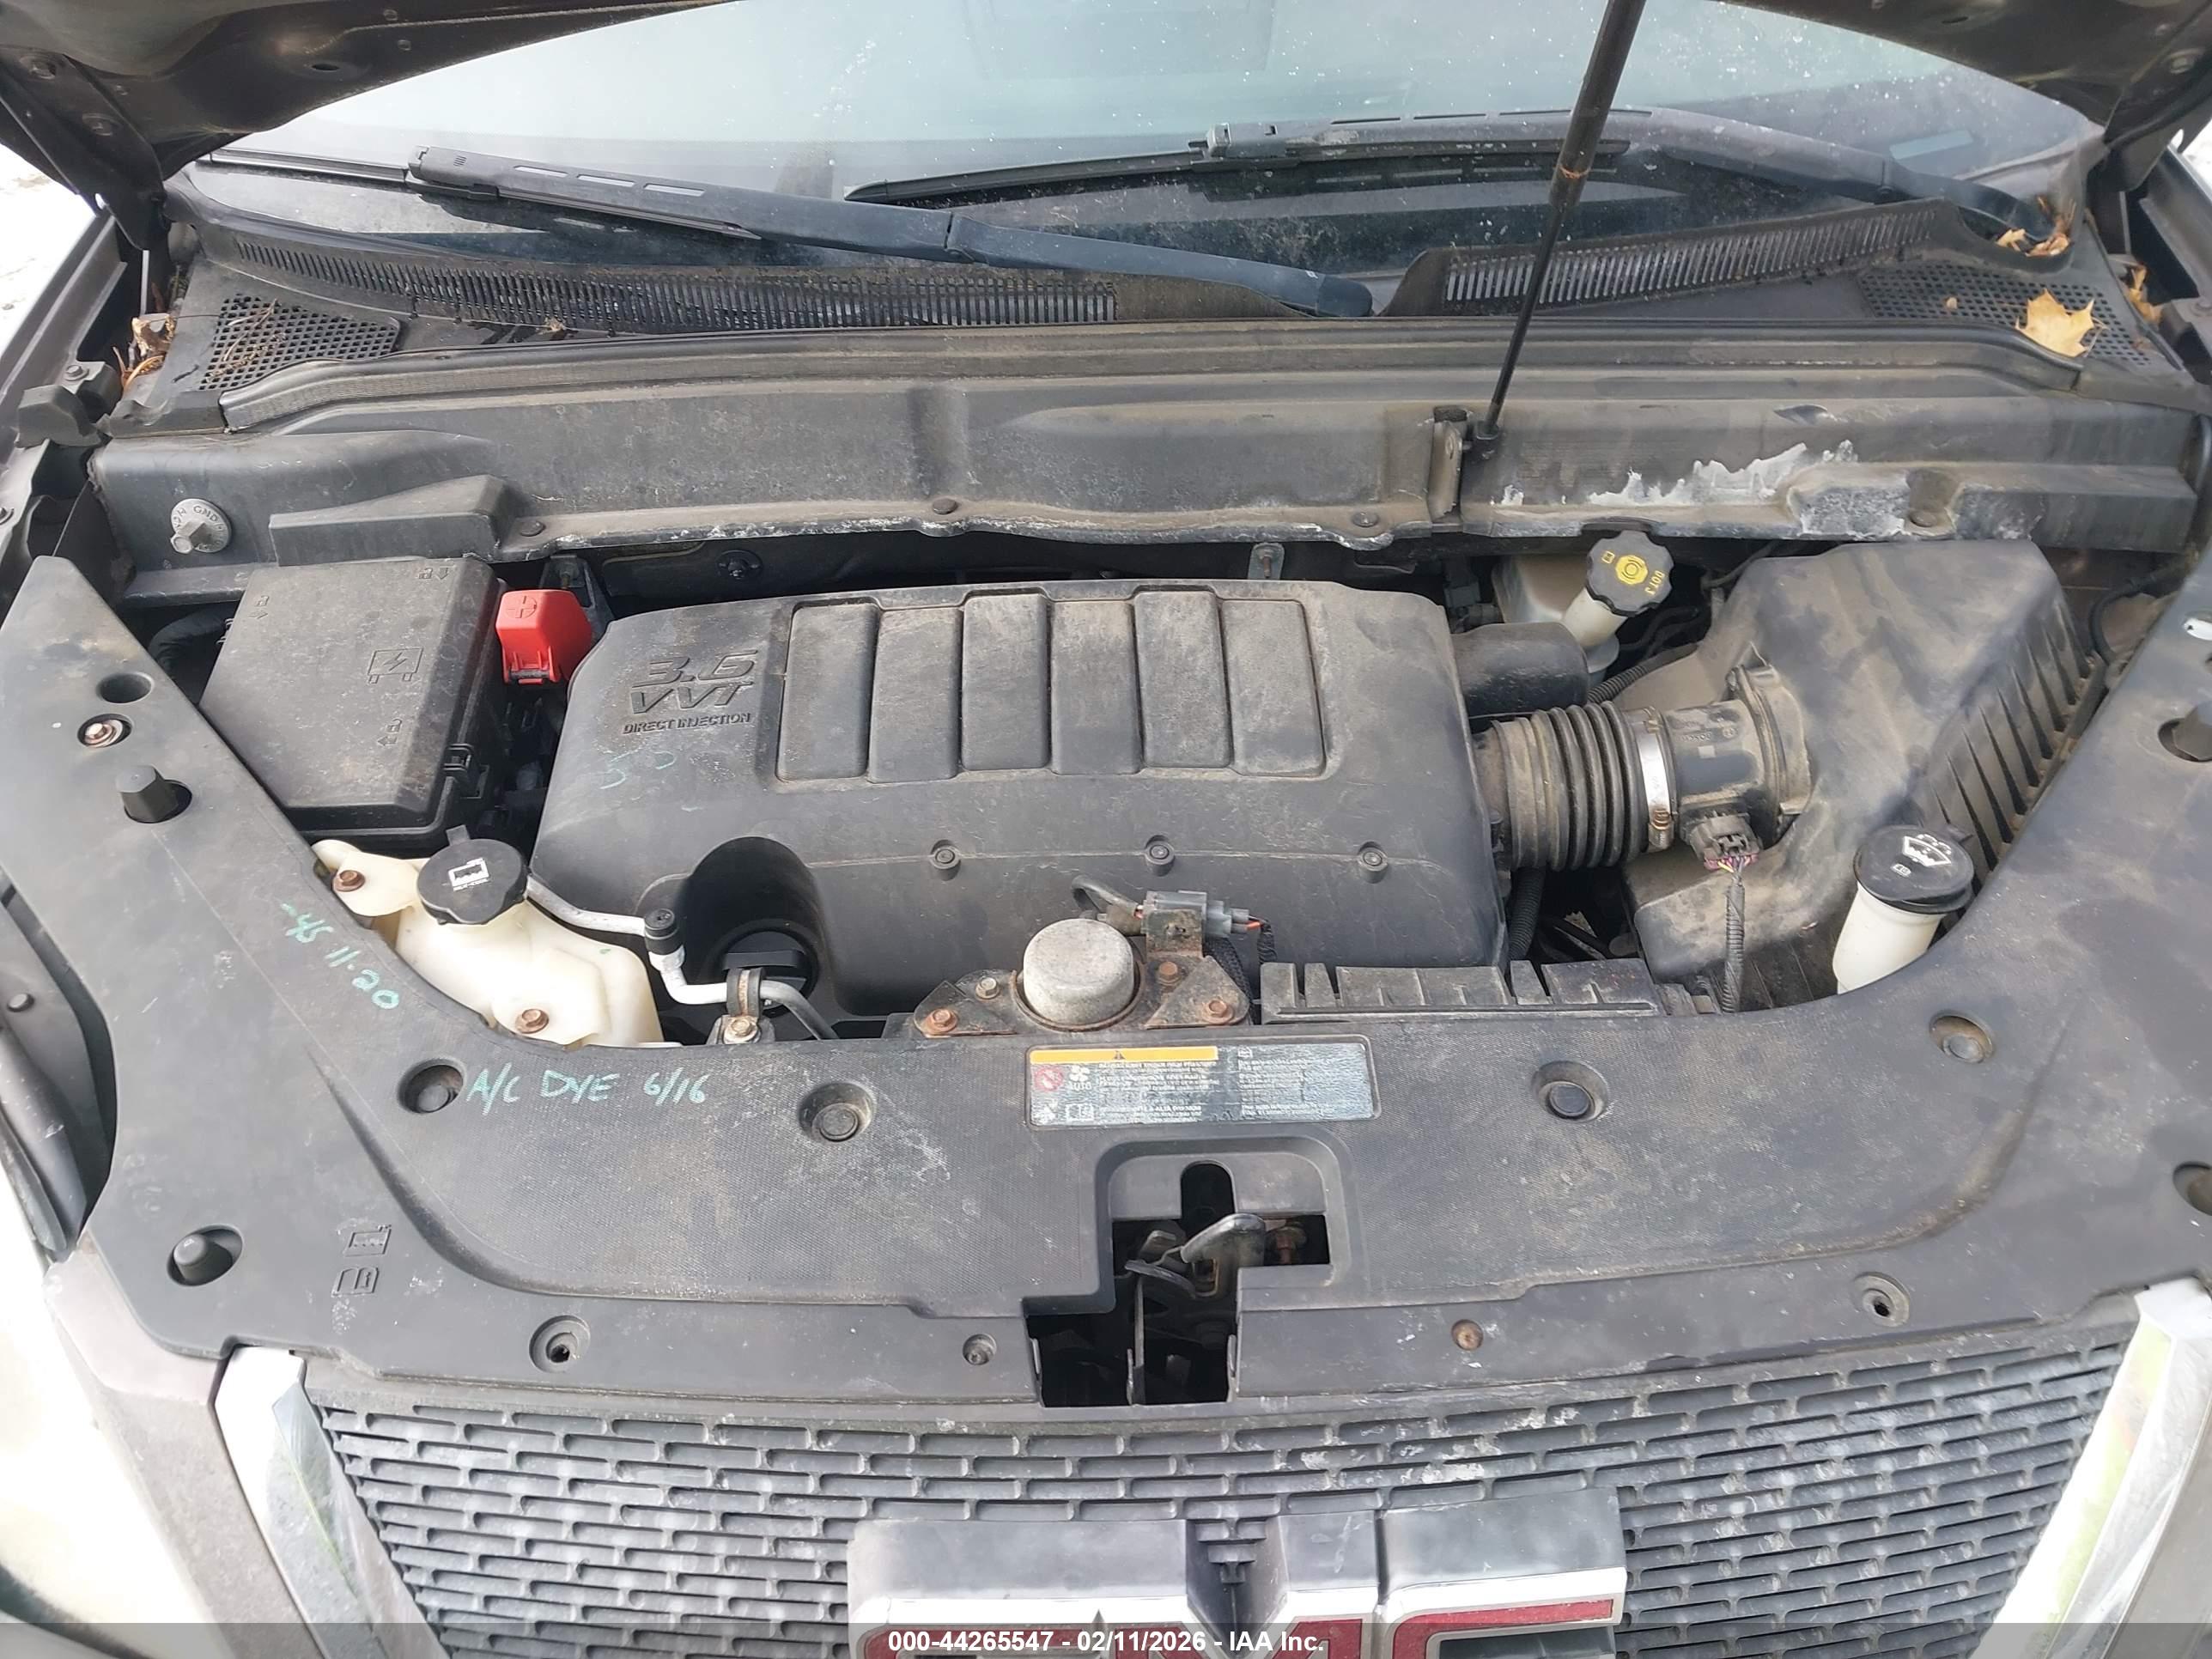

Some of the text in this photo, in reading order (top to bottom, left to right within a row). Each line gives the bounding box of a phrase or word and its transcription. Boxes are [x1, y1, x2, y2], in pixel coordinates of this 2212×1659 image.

[1649, 569, 1665, 589] DOT
[631, 650, 758, 688] 3.6
[630, 681, 755, 714] VVT
[623, 713, 751, 734] DIRECT INJECTION
[466, 1062, 521, 1115] A/C
[540, 1069, 620, 1104] DYE
